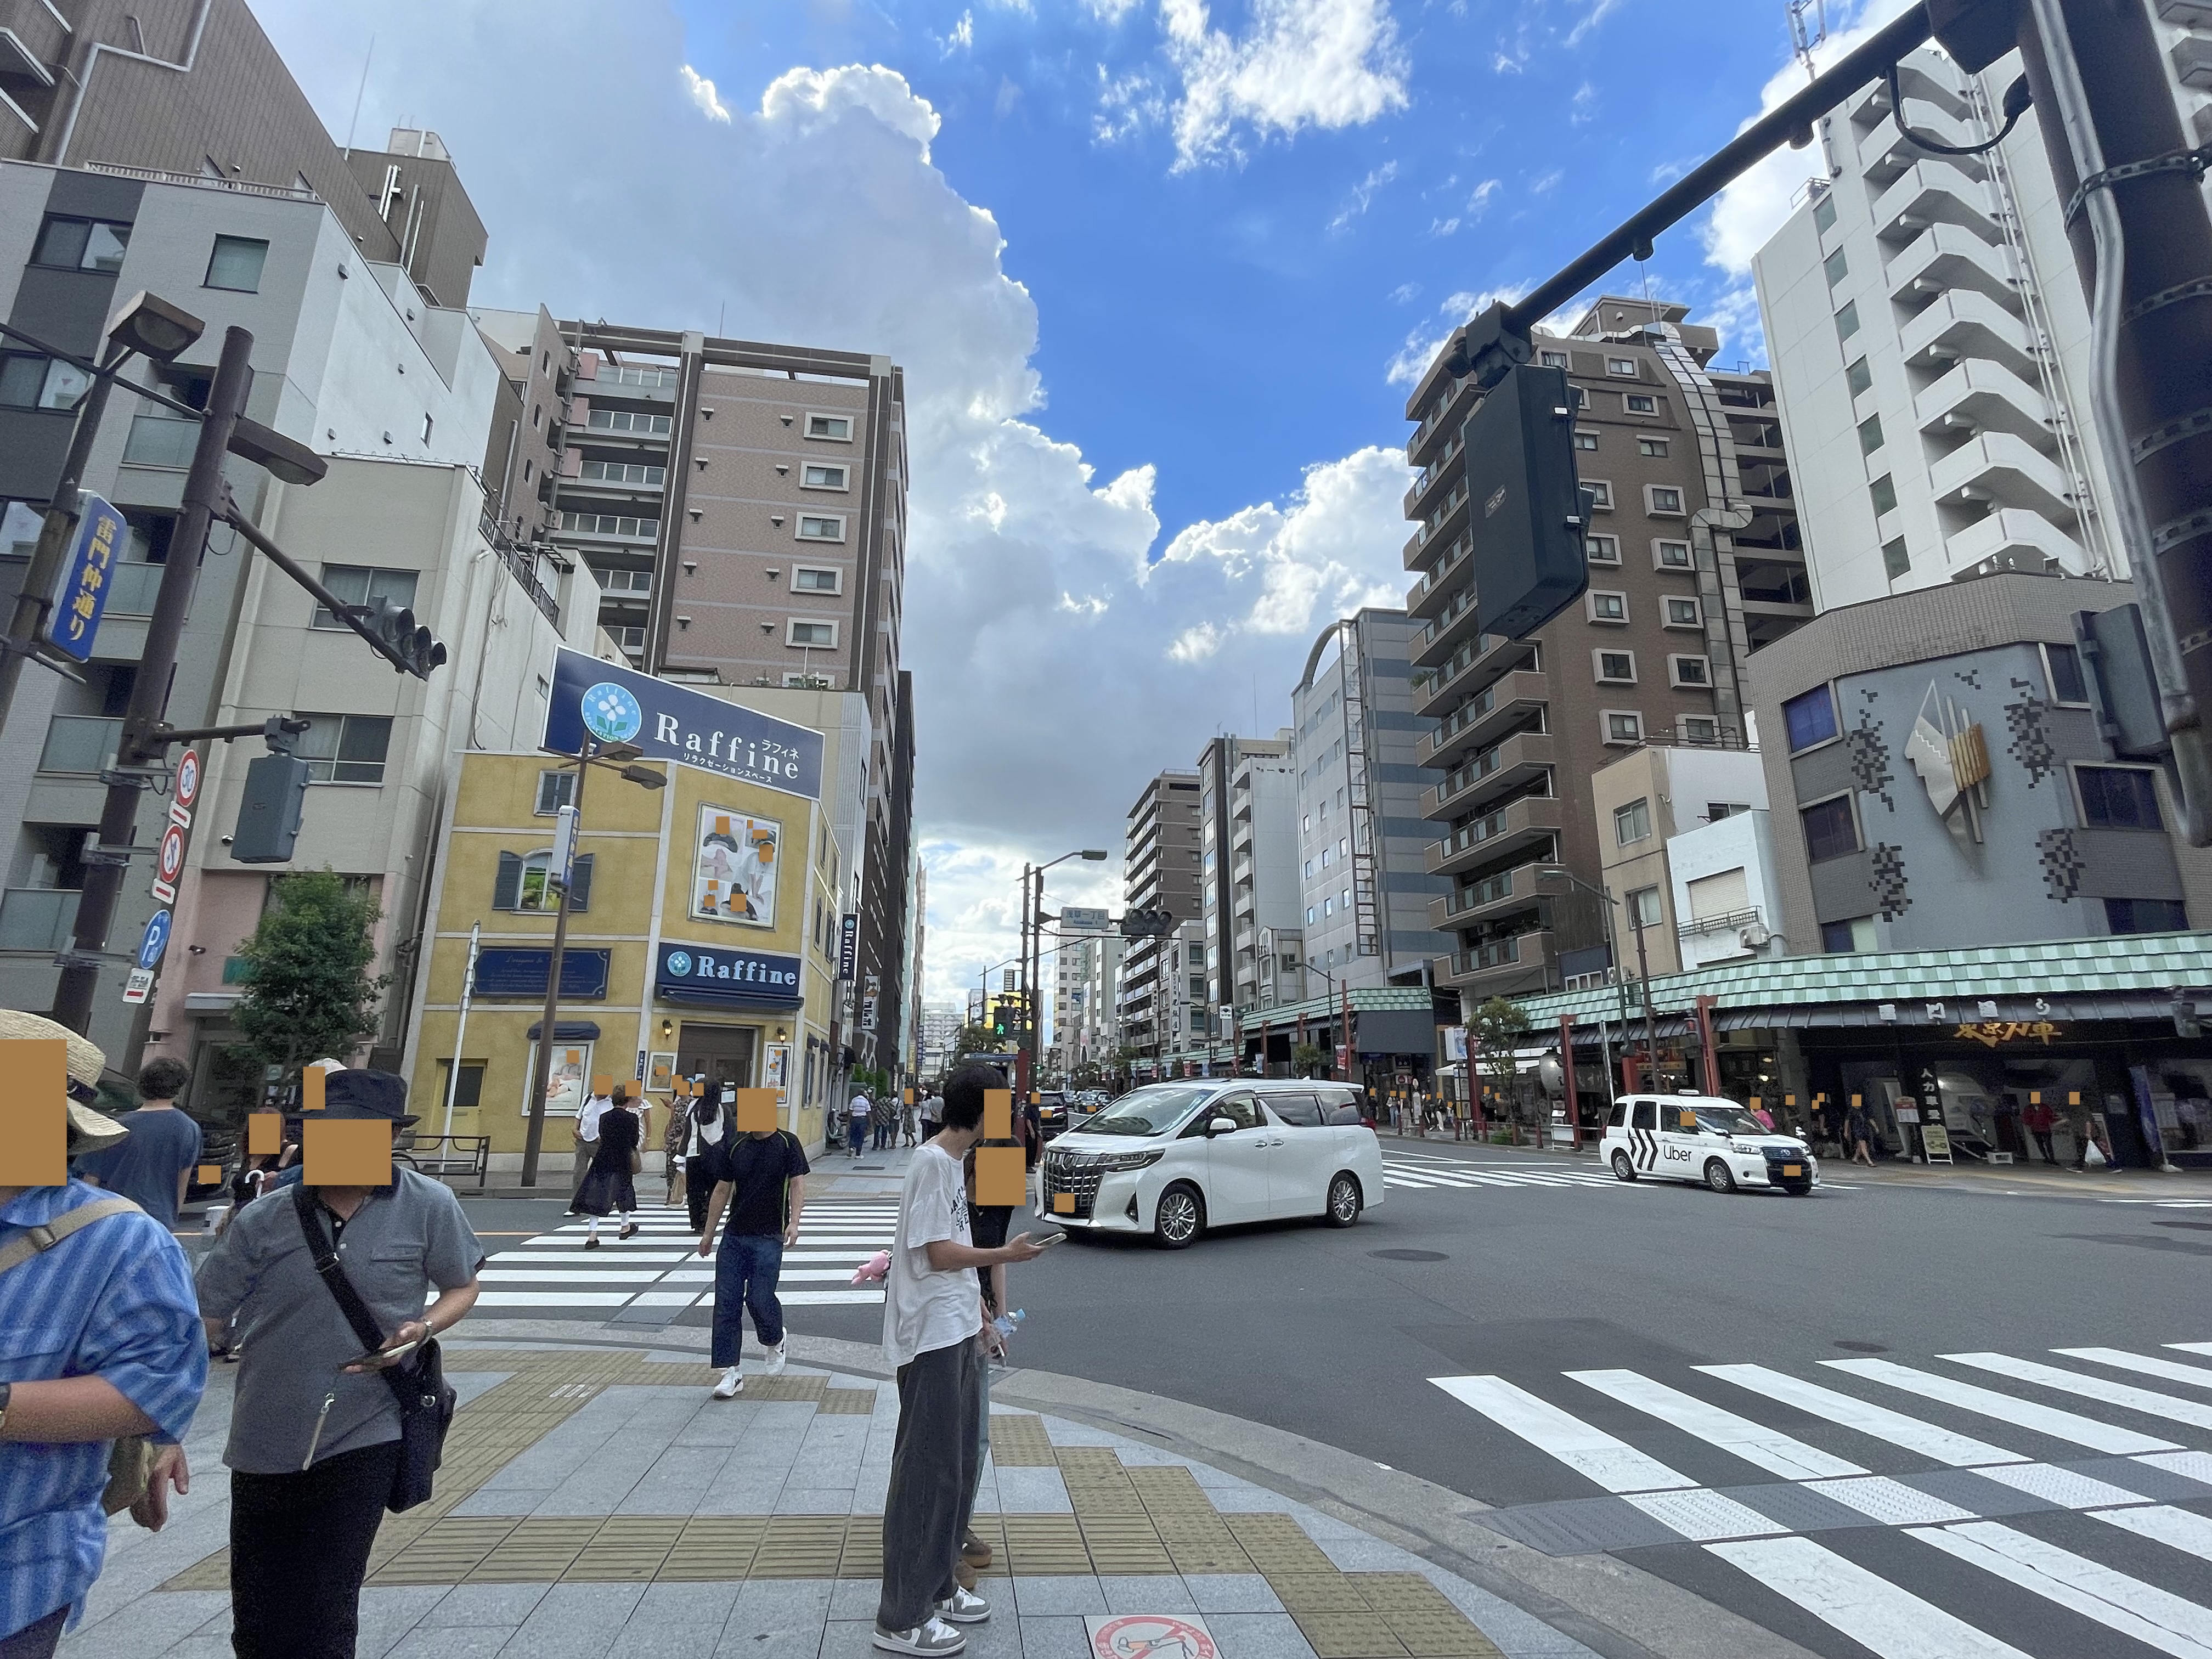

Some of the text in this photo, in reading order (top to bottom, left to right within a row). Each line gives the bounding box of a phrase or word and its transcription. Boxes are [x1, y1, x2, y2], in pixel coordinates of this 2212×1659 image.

[653, 712, 799, 779] Raffine
[761, 738, 799, 760] ラフィネ
[683, 752, 772, 783] リラクゼーションスペース
[842, 930, 854, 974] Raffine
[696, 955, 796, 986] Raffine
[1663, 1144, 1692, 1162] Uber
